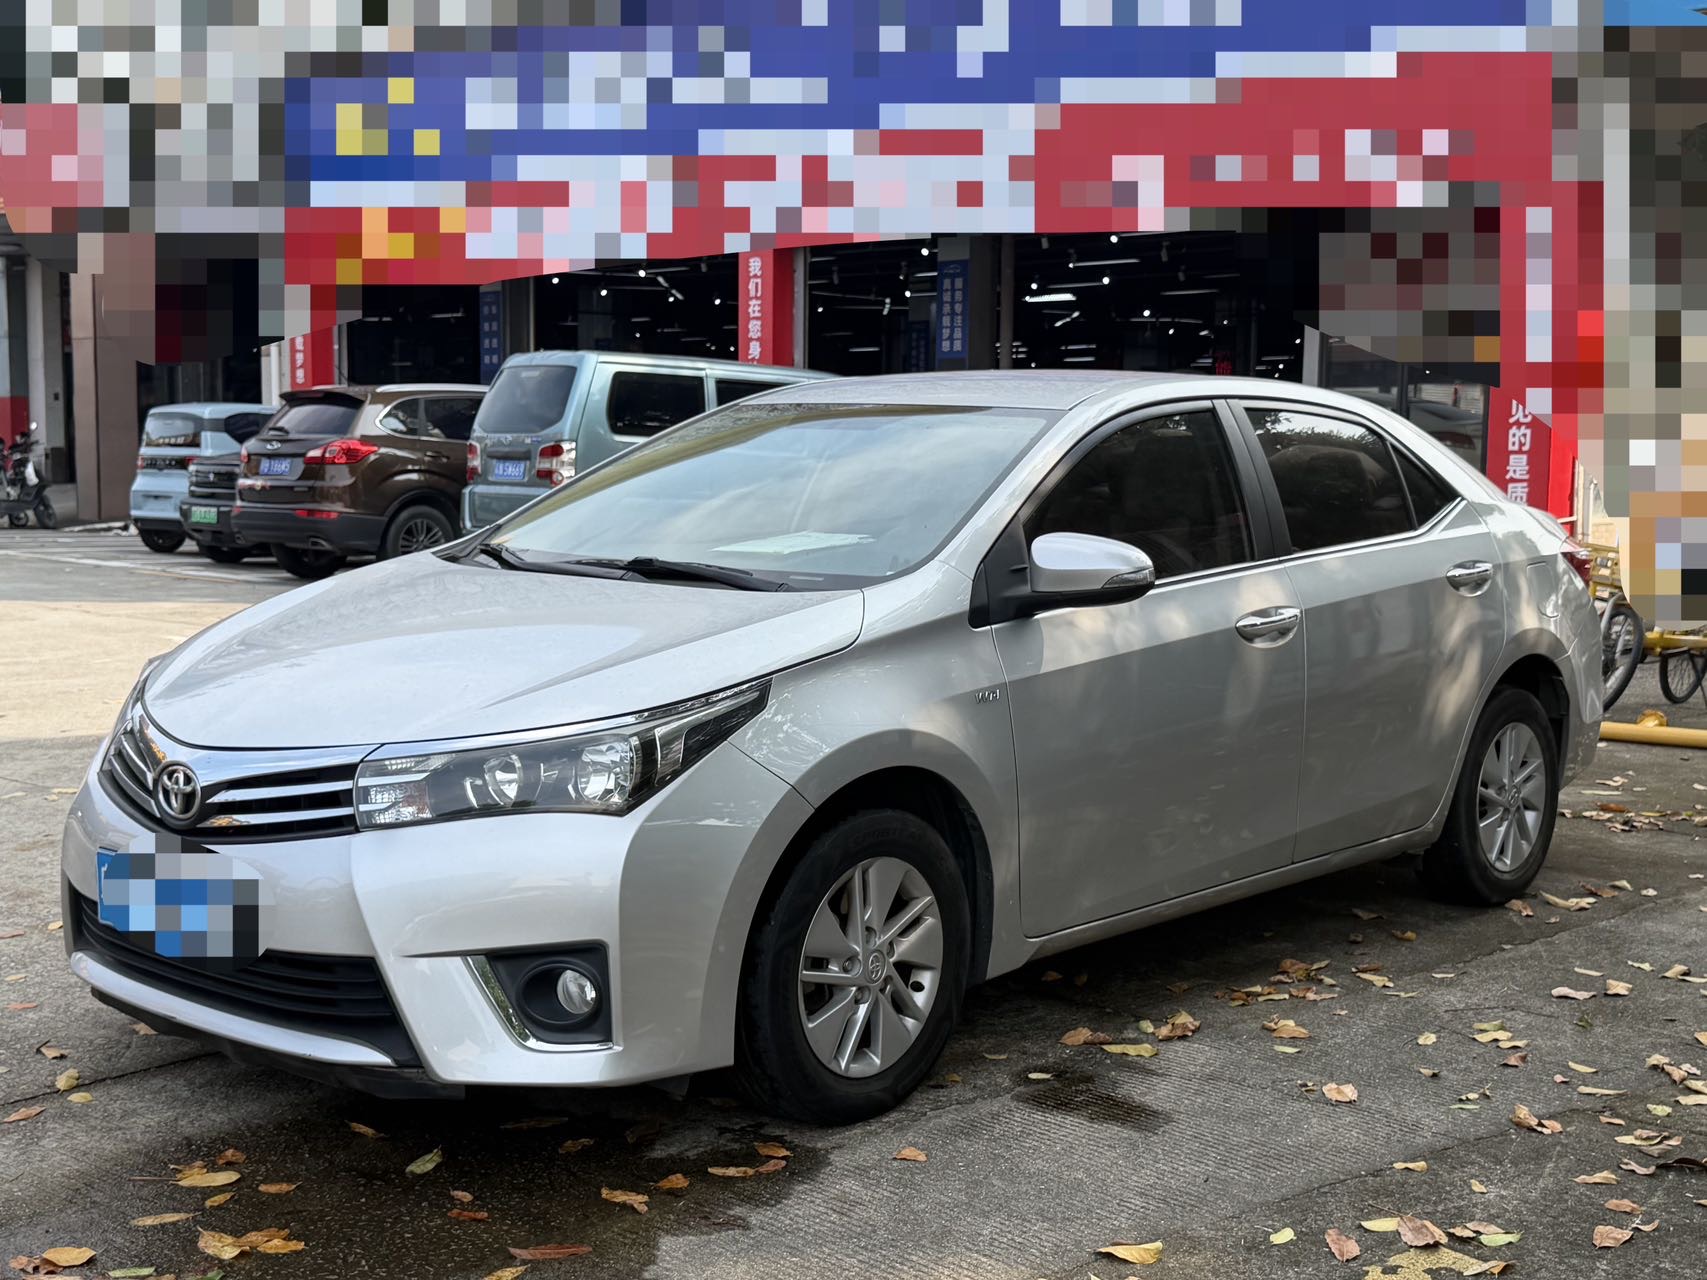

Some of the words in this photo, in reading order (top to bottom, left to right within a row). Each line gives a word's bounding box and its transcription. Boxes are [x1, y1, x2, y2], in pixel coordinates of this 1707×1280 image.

[748, 257, 762, 364] 我们在您身
